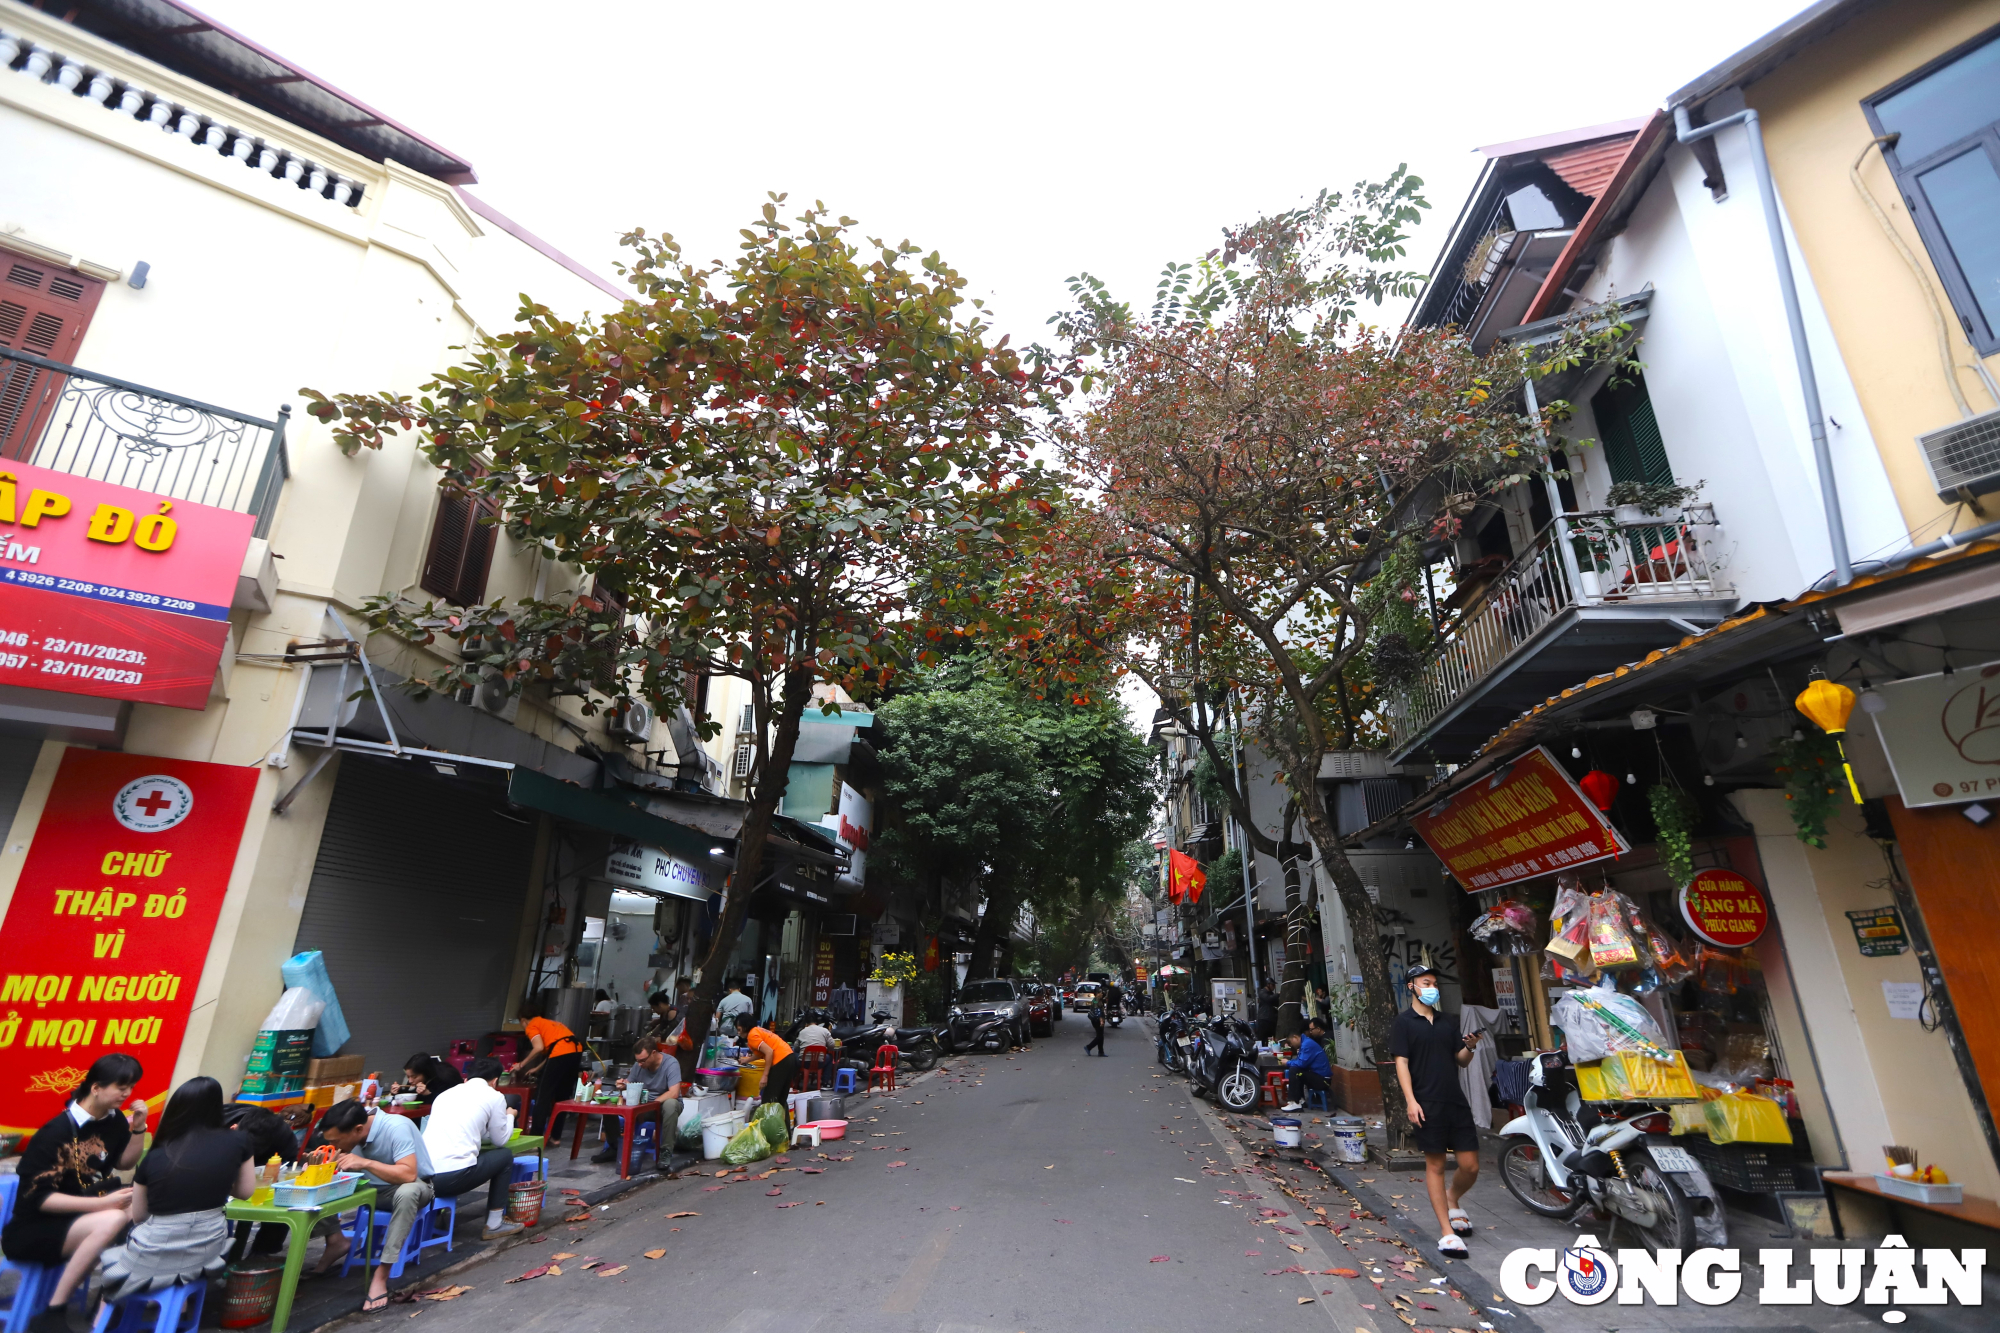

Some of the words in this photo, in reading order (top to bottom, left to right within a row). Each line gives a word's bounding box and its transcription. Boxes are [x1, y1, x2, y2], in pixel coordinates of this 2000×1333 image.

[86, 501, 178, 552] ĐỎ
[18, 572, 55, 586] 3926
[126, 591, 159, 605] 3926
[162, 598, 195, 611] 2209
[1511, 772, 1558, 814] GIANG
[1960, 780, 1979, 793] 97
[1455, 801, 1493, 837] VÀNG
[1475, 790, 1507, 829] MÃ
[1441, 816, 1473, 848] HÀNG
[100, 849, 172, 877] CHỮ
[654, 858, 672, 877] PHỞ
[671, 863, 701, 886] CHUYÊN
[1698, 876, 1718, 891] CỬA
[1719, 877, 1745, 892] HÀNG
[54, 887, 137, 922] THẬP
[143, 887, 187, 918] ĐỎ
[1691, 894, 1734, 913] VÀNG
[1737, 895, 1762, 913] MÃ
[1704, 915, 1727, 933] PHÚC
[1729, 919, 1757, 933] GIANG
[93, 928, 126, 959] VÌ
[1, 975, 74, 1008] MỌI
[78, 970, 182, 1002] NGƯỜI
[816, 973, 830, 988] LẨU
[816, 989, 827, 1002] BÒ
[0, 1012, 22, 1047] Ở
[25, 1019, 97, 1052] MỌI
[102, 1015, 163, 1045] NƠI
[1654, 1147, 1683, 1159] 34-B2
[1658, 1159, 1695, 1170] 82031
